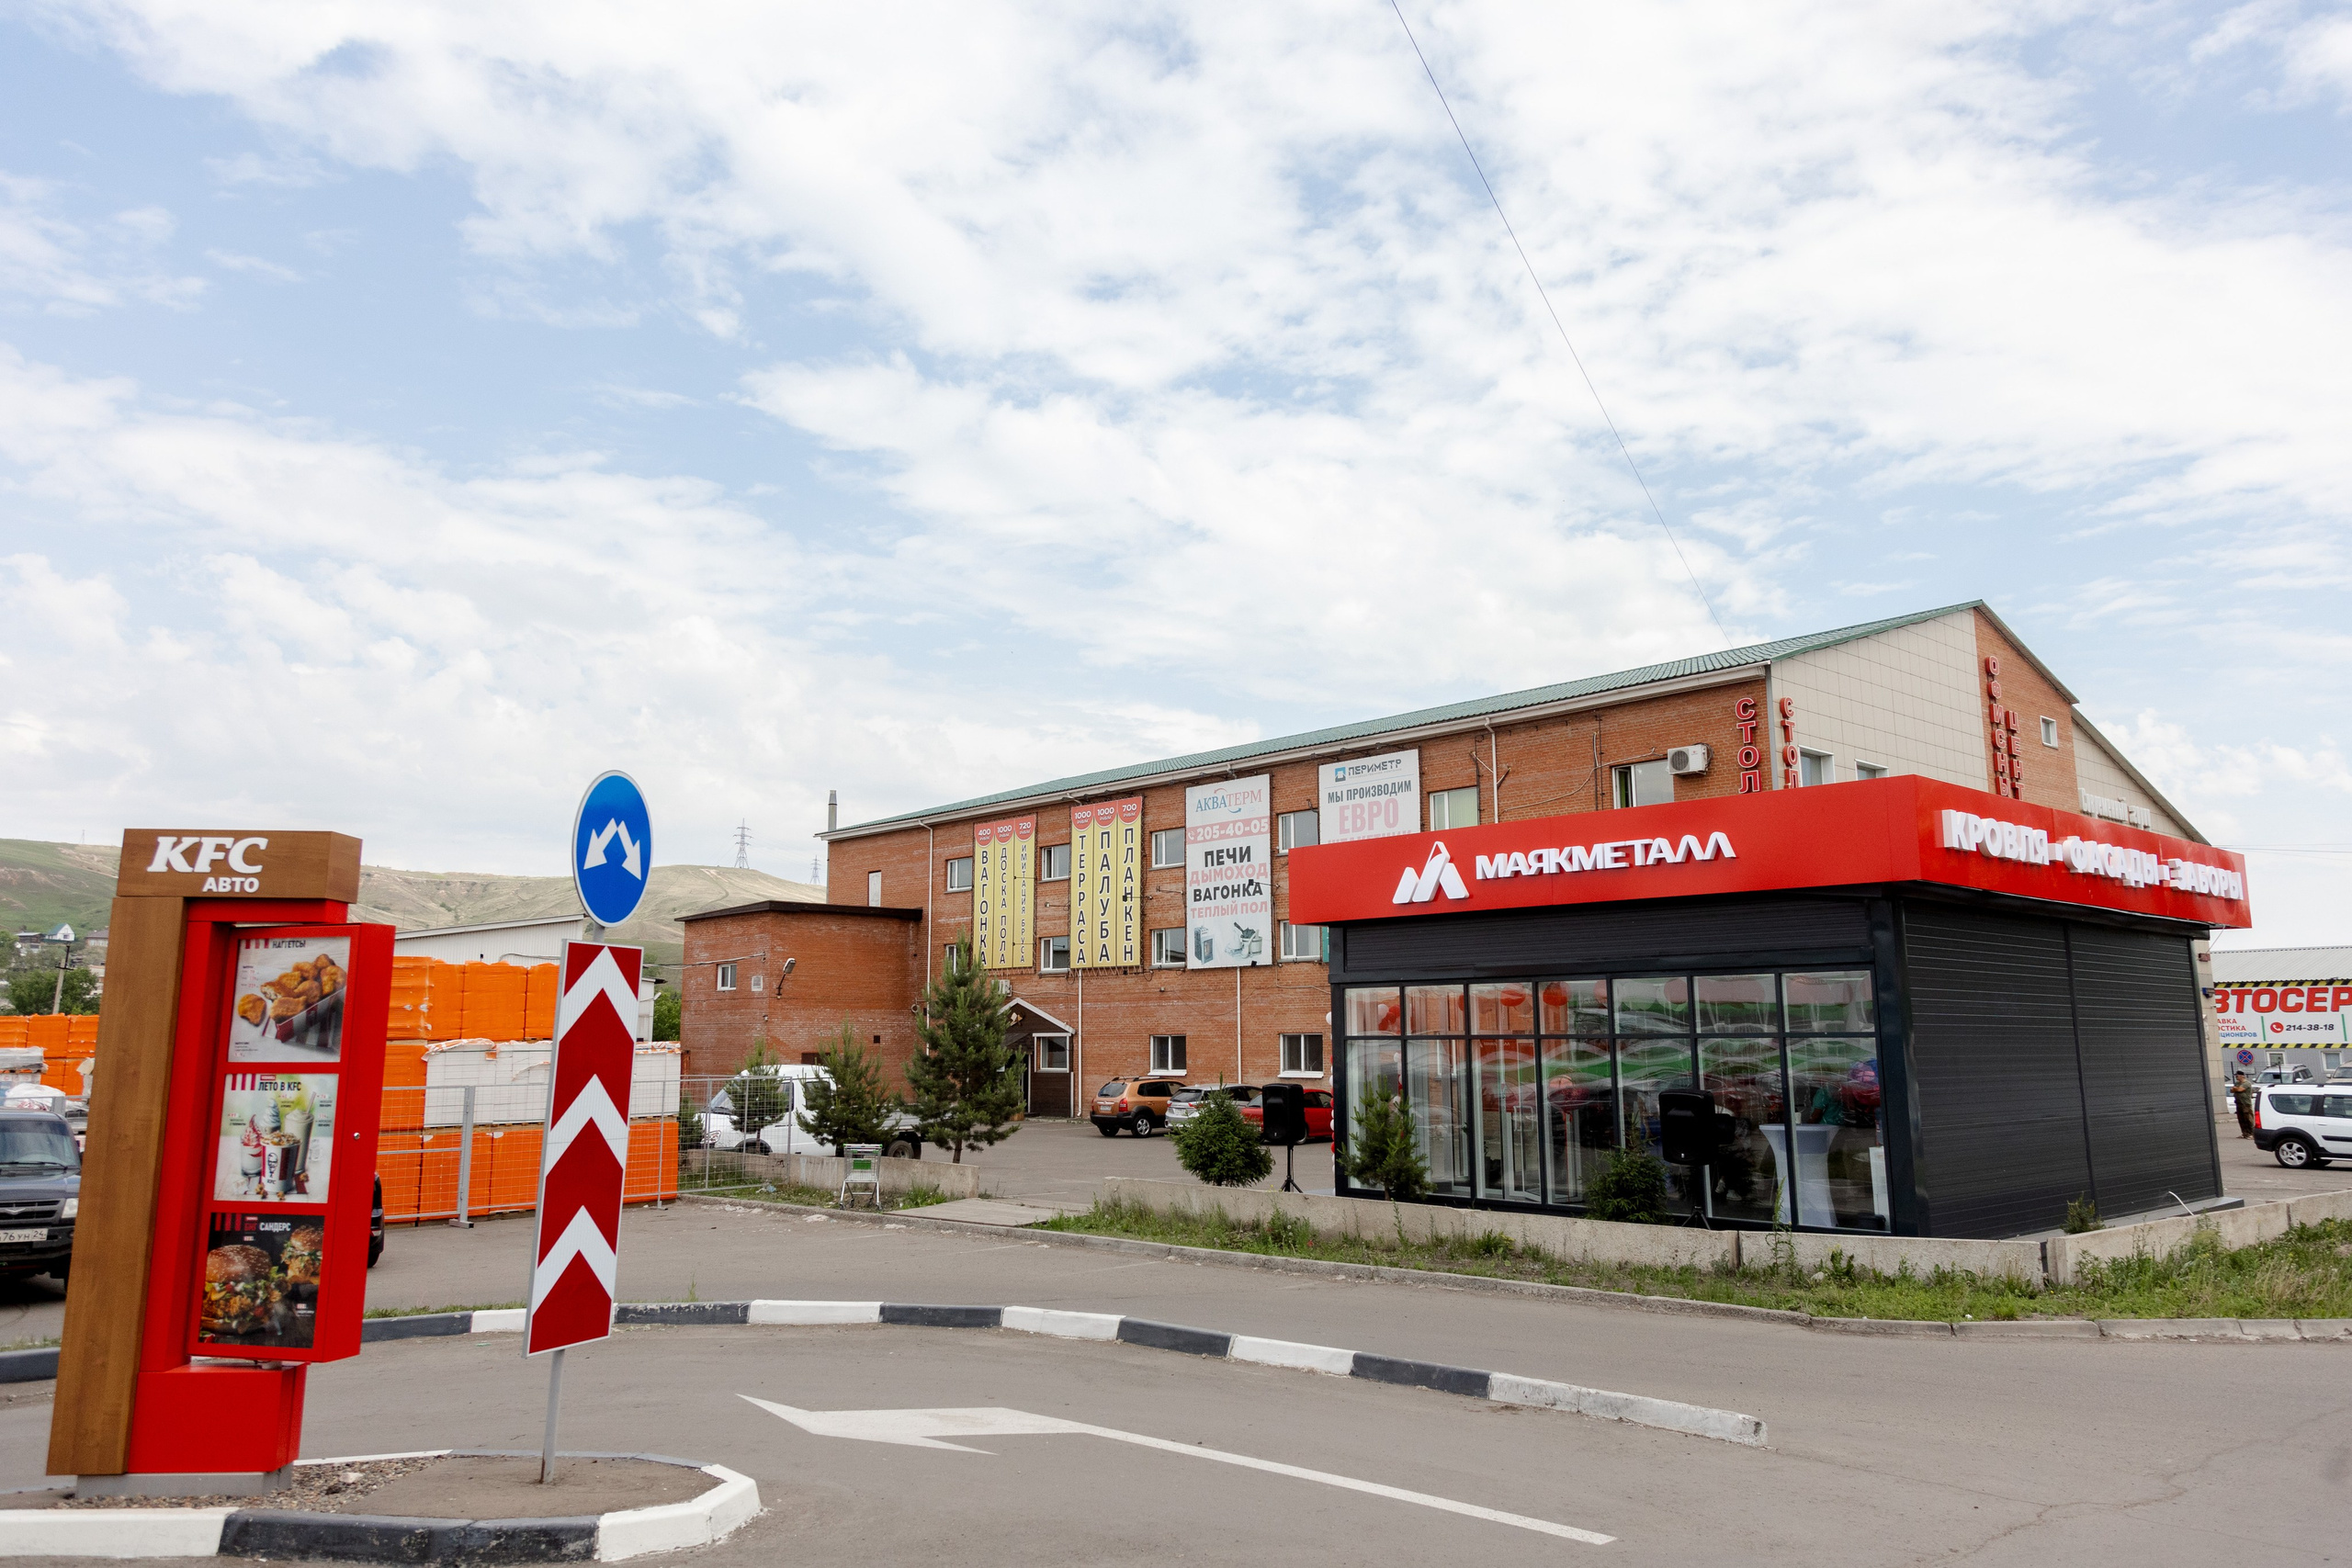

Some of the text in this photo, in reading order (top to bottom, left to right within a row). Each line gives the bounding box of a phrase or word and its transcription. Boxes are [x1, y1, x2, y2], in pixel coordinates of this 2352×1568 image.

[1348, 759, 1402, 776] ПЕРИМЕТР
[1195, 788, 1262, 813] АКВАТЕРМ
[1328, 780, 1412, 804] МЫ ПРОИЗВОДИМ
[1074, 810, 1091, 819] 1000
[1097, 807, 1114, 816] 1000
[1122, 804, 1137, 812] 700
[1339, 797, 1399, 835] ЕВРО
[1196, 818, 1269, 841] 205-40-05
[146, 836, 268, 874] KFC
[1204, 845, 1251, 867] ПЕЧИ
[1476, 831, 1736, 880] МАЯКМЕТАЛЛ
[1942, 809, 2244, 900] КРОВЛЯ ФАСАДЫ ЗАБОРЫ
[202, 876, 259, 893] АВТО
[1189, 863, 1268, 886] ДЫМОХОД
[1077, 835, 1086, 964] ТЕРРАСА
[1099, 831, 1110, 962] ПАЛУБА
[1124, 828, 1134, 962] ПЛАНКЕН
[1193, 882, 1263, 902] ВАГОНКА
[979, 850, 989, 965] ВАГОНКА
[1191, 900, 1268, 919] ТЕПЛЫЙ ПОЛ
[2286, 1023, 2335, 1032] 214-38-18
[258, 1082, 301, 1091] ЛЕТО В KFC
[259, 1223, 291, 1232] САНДЕРС
